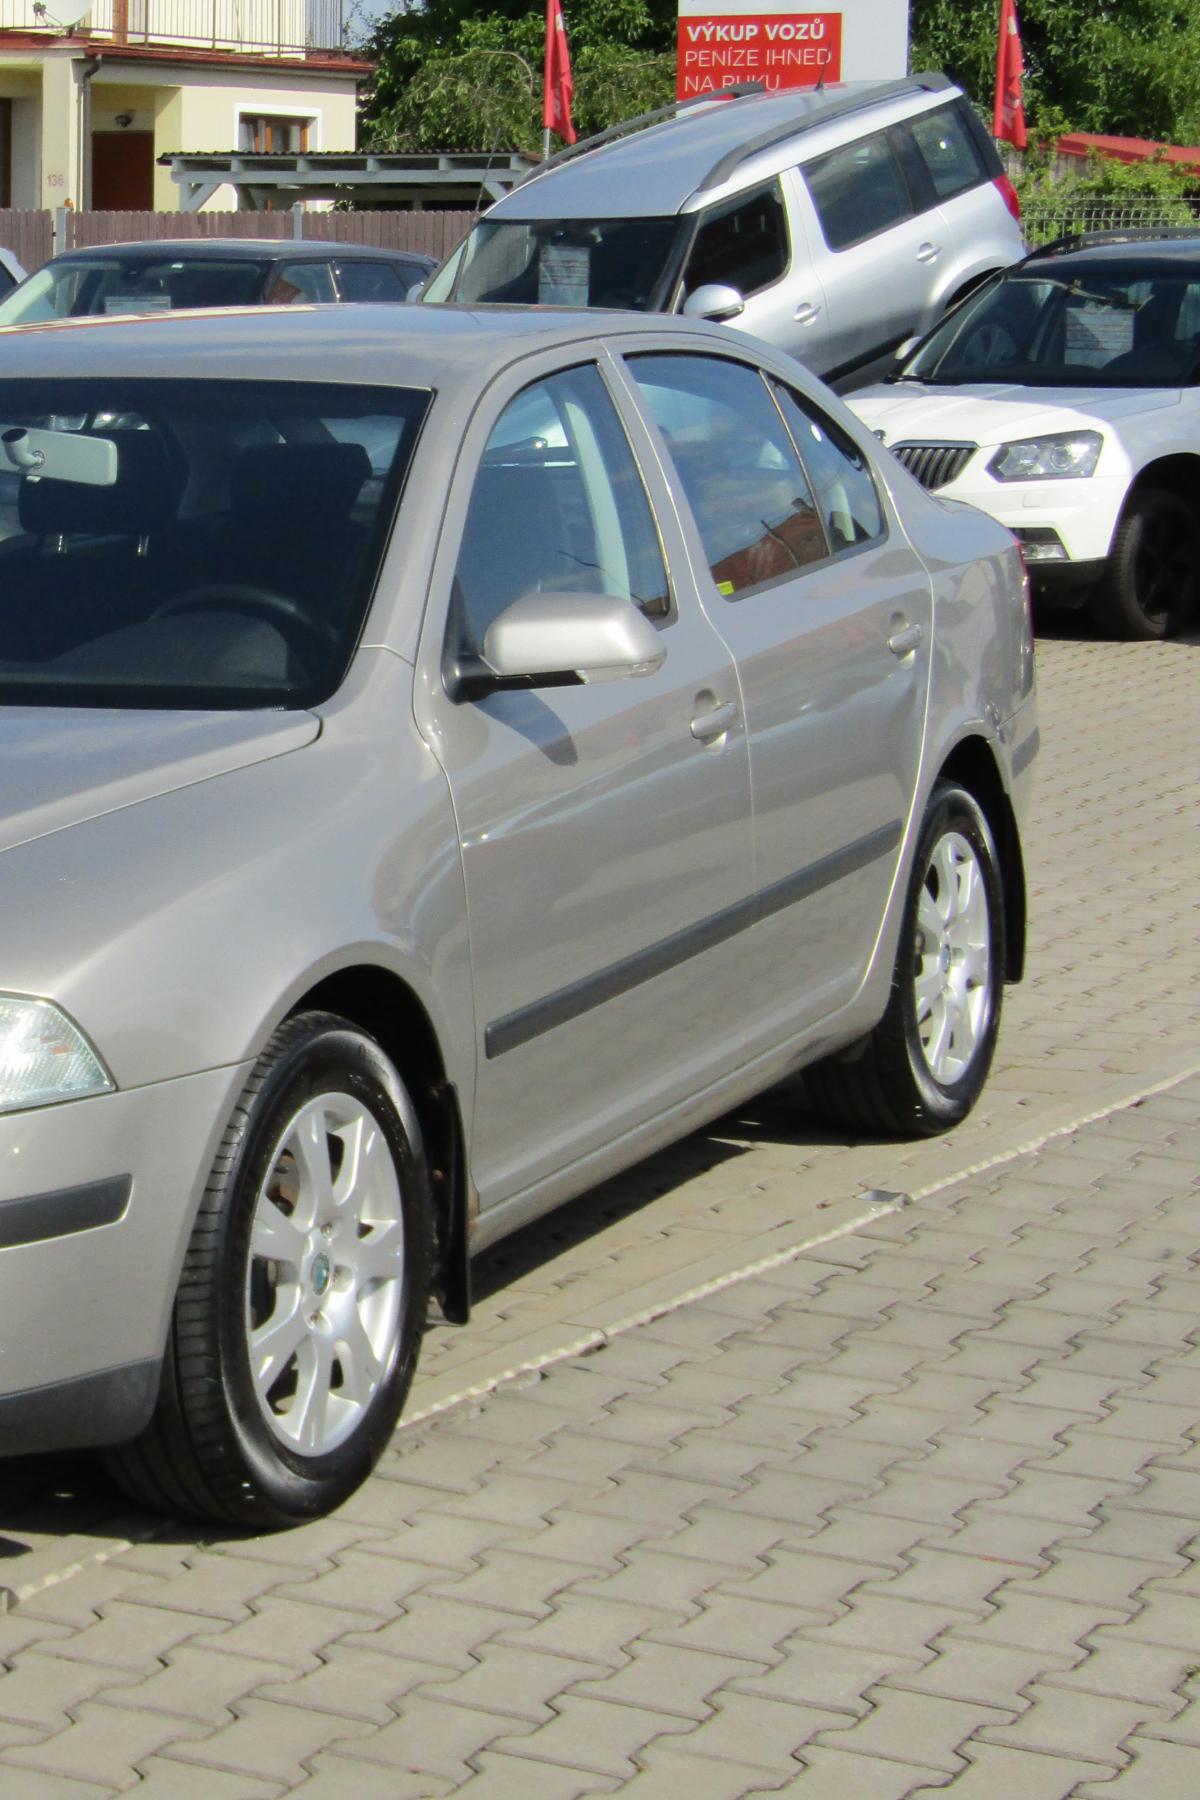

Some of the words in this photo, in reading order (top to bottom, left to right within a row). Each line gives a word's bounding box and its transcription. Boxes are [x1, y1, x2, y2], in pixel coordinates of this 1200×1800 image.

[687, 21, 759, 42] VÝKUP
[765, 18, 825, 41] VOZŮ
[685, 47, 759, 67] PENÍZE
[766, 48, 832, 66] IHNED
[684, 75, 714, 92] NA
[47, 174, 65, 186] 136
